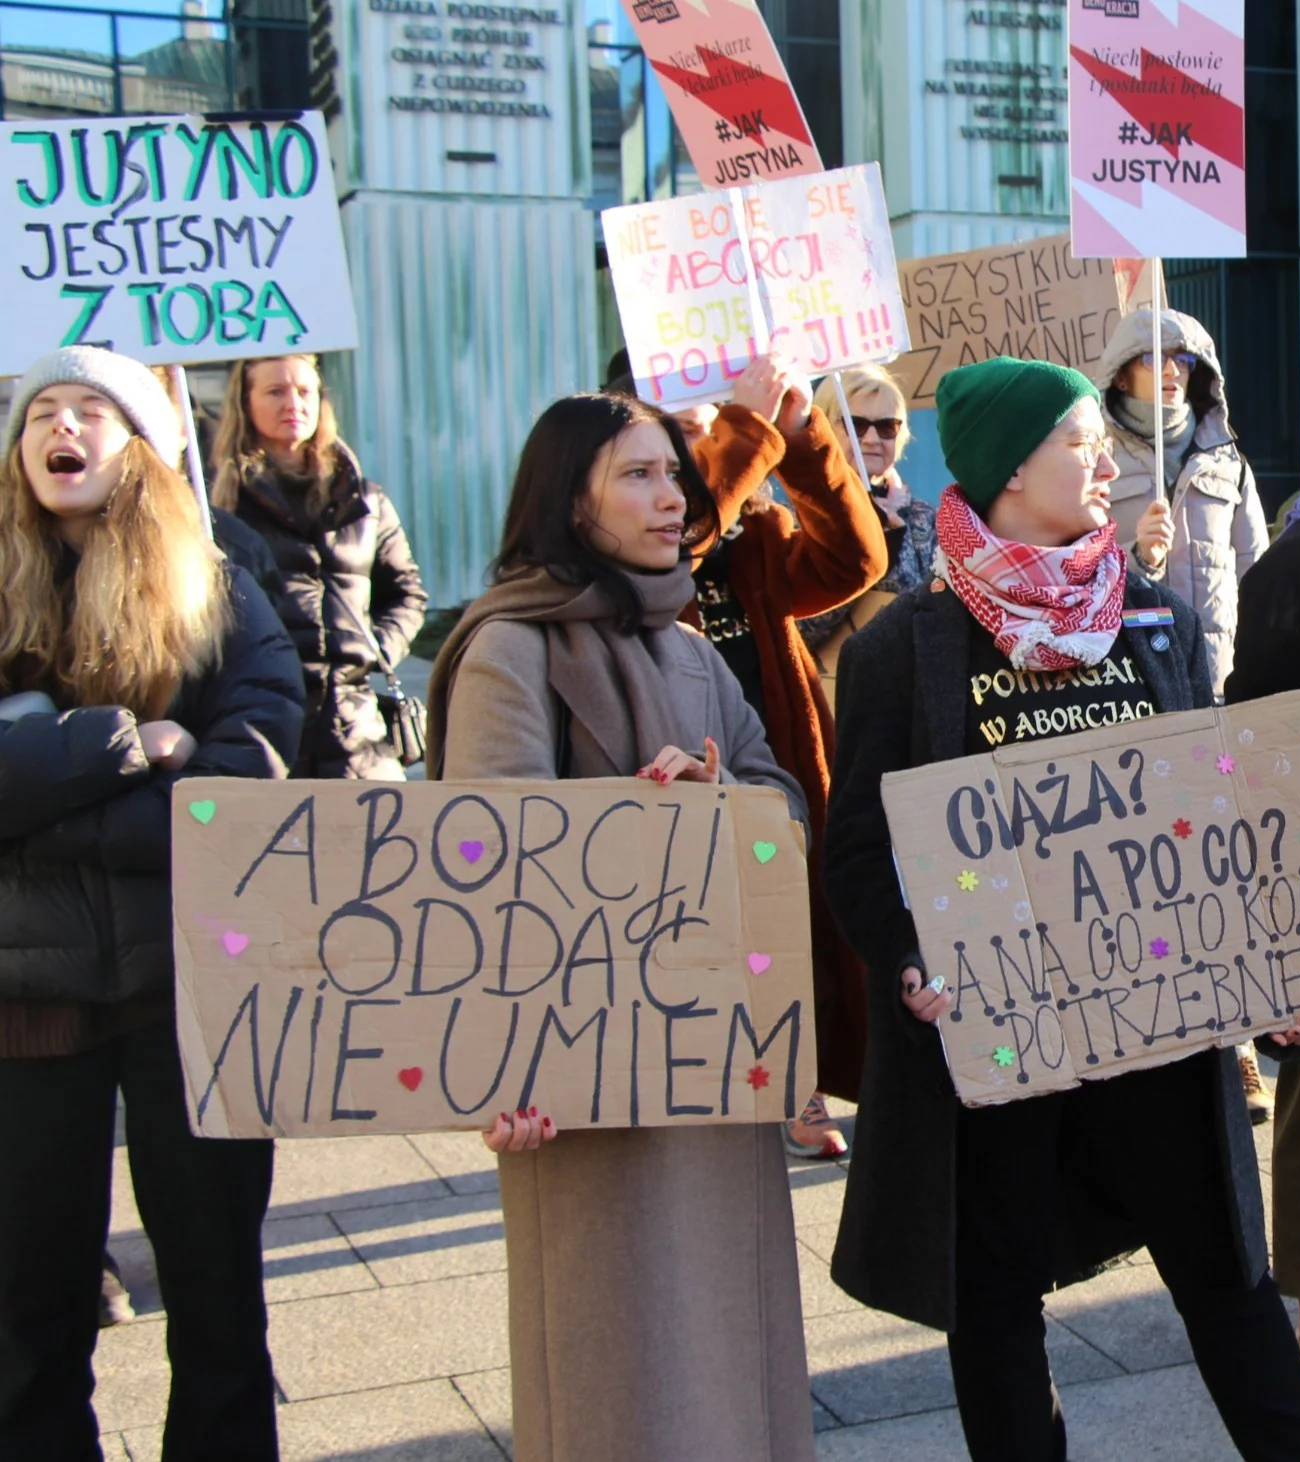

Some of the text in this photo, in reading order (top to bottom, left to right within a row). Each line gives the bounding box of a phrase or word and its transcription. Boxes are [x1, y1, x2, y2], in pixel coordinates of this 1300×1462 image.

[1090, 73, 1096, 92] i
[1099, 75, 1177, 97] posłanki
[1181, 76, 1223, 99] będą
[1092, 47, 1223, 71] Niech posłowie
[715, 109, 770, 143] #JAK
[1118, 121, 1193, 146] #JAK
[715, 143, 803, 184] JUSTYNA
[1092, 158, 1221, 184] JUSTYNA
[22, 214, 294, 281] JESTESMY
[617, 213, 667, 257] NIE
[805, 182, 857, 222] SIĘ
[666, 231, 825, 294] ABORCJI
[60, 279, 310, 350] Z TOBĄ
[919, 287, 1056, 343] NAS NIE
[980, 699, 1156, 746] W ABORCJAC
[317, 898, 710, 1010] ODDAĆ
[1088, 912, 1143, 983] CO
[1152, 892, 1226, 966] TO
[440, 997, 801, 1127] UMIEM
